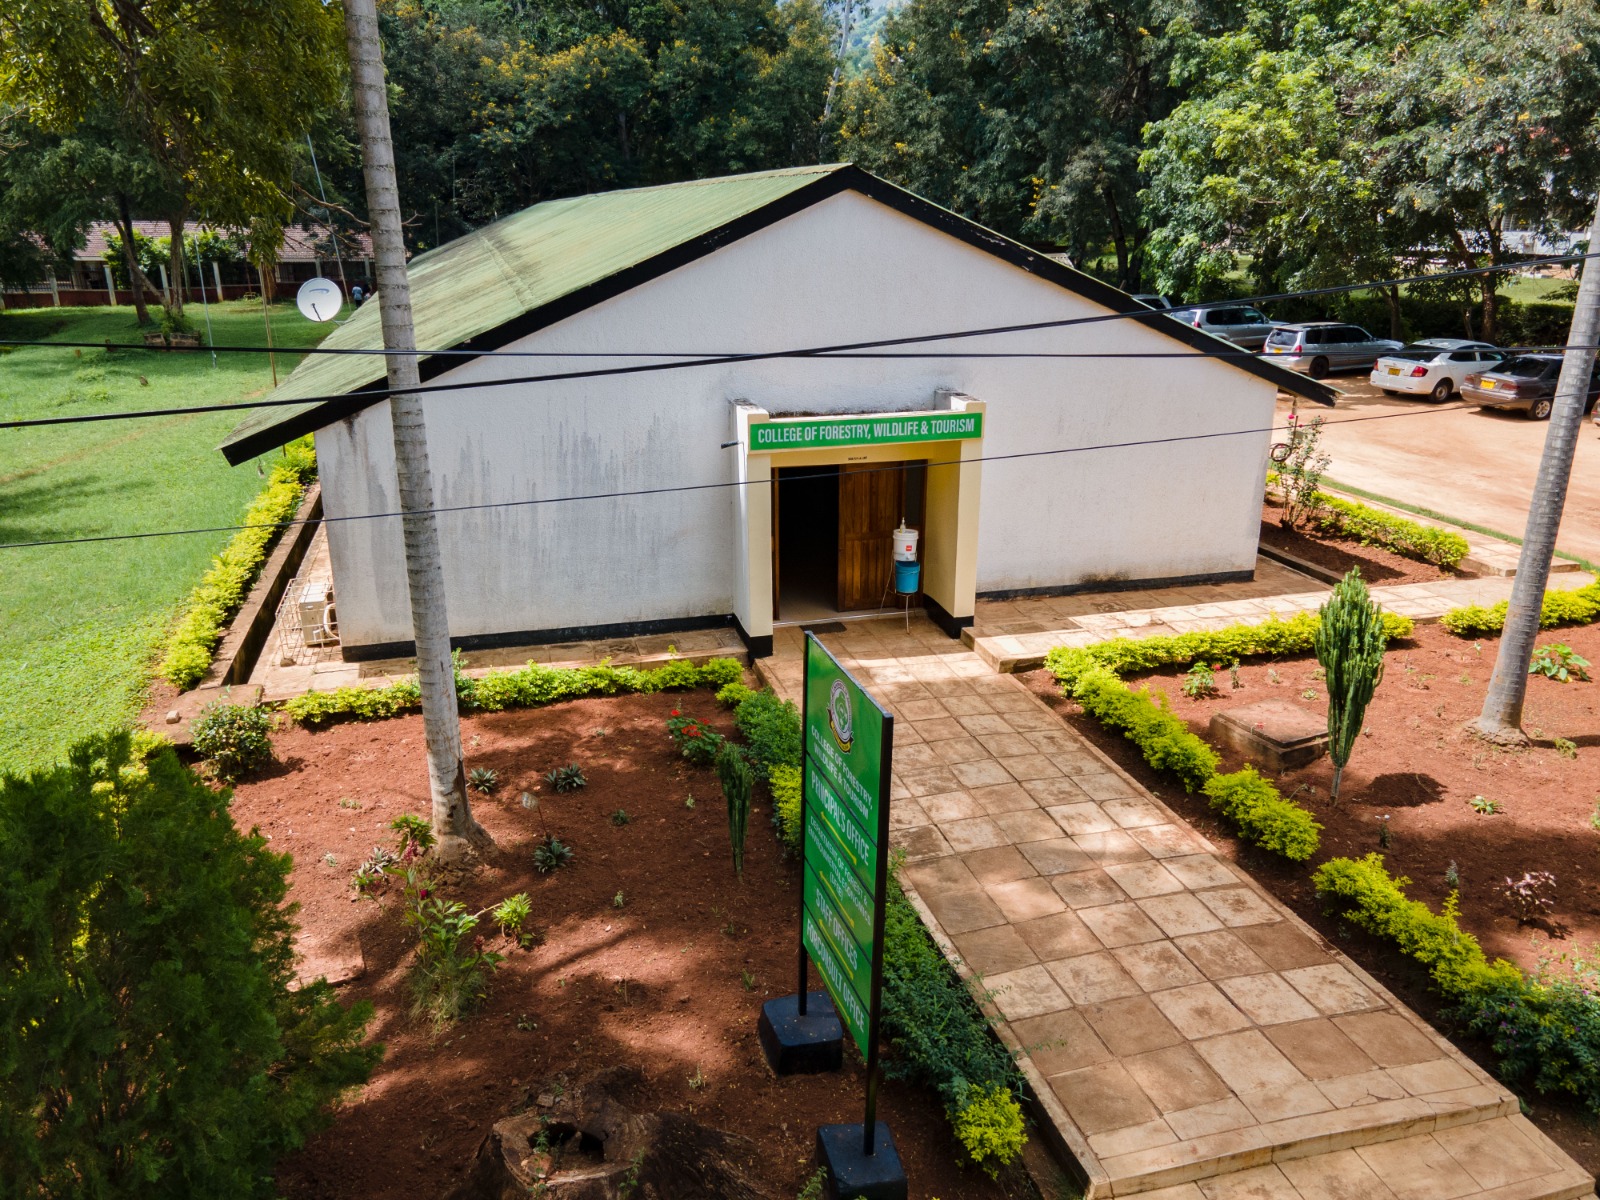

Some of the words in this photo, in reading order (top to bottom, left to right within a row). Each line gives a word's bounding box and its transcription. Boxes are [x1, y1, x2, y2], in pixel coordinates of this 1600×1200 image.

[758, 427, 802, 444] COLLEGE
[804, 426, 817, 441] OF
[819, 424, 871, 440] FORESTRY,
[873, 421, 919, 438] WILDLIFE
[920, 420, 928, 435] &
[930, 418, 975, 434] TOURISM
[811, 725, 834, 759] COLLEGE
[834, 753, 842, 767] OF
[842, 762, 872, 810] FORESTRY,
[814, 742, 837, 779] WILDLIFE
[838, 772, 843, 785] &
[843, 778, 868, 819] TOURISM
[811, 770, 845, 833] PRINCIPAL'S
[846, 818, 869, 866] OFFICE
[815, 888, 832, 928] STAFF
[832, 917, 858, 970] OFFICES
[806, 918, 842, 992] FORCONSULT
[842, 982, 865, 1033] OFFICE
